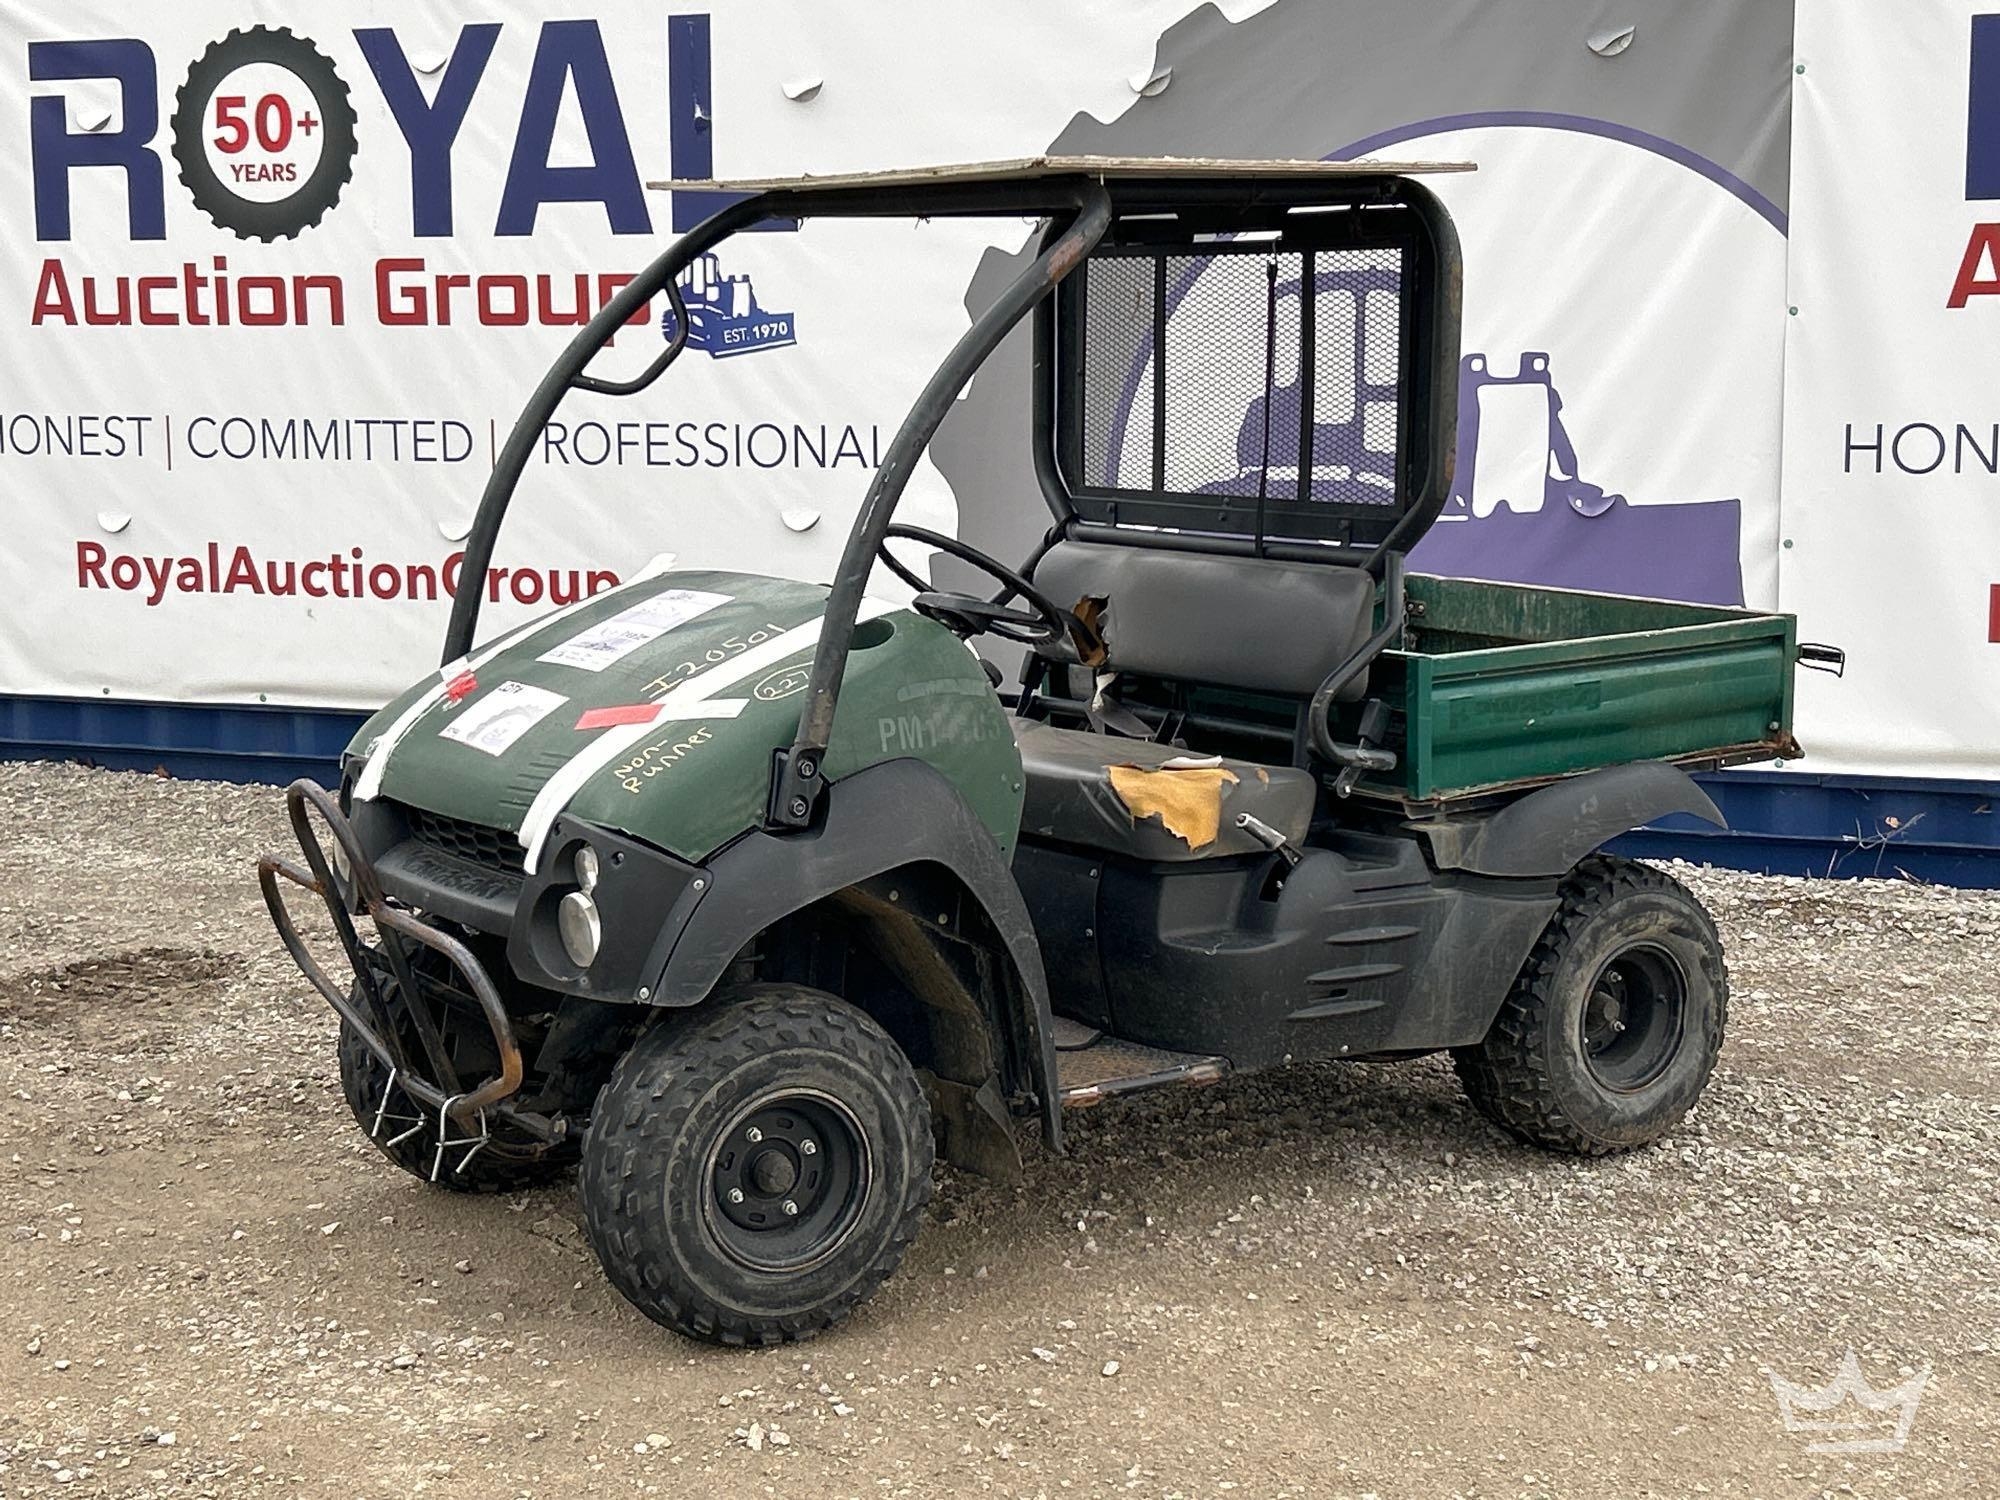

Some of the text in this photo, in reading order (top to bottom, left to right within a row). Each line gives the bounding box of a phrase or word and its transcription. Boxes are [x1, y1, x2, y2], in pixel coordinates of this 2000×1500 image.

[213, 93, 319, 154] 50+
[230, 163, 297, 183] YEARS
[31, 255, 345, 326] Auction
[723, 321, 789, 344] EST. 1970
[0, 414, 884, 469] ONEST COMMITTED ROFESSIONAL
[621, 726, 713, 794] Runner
